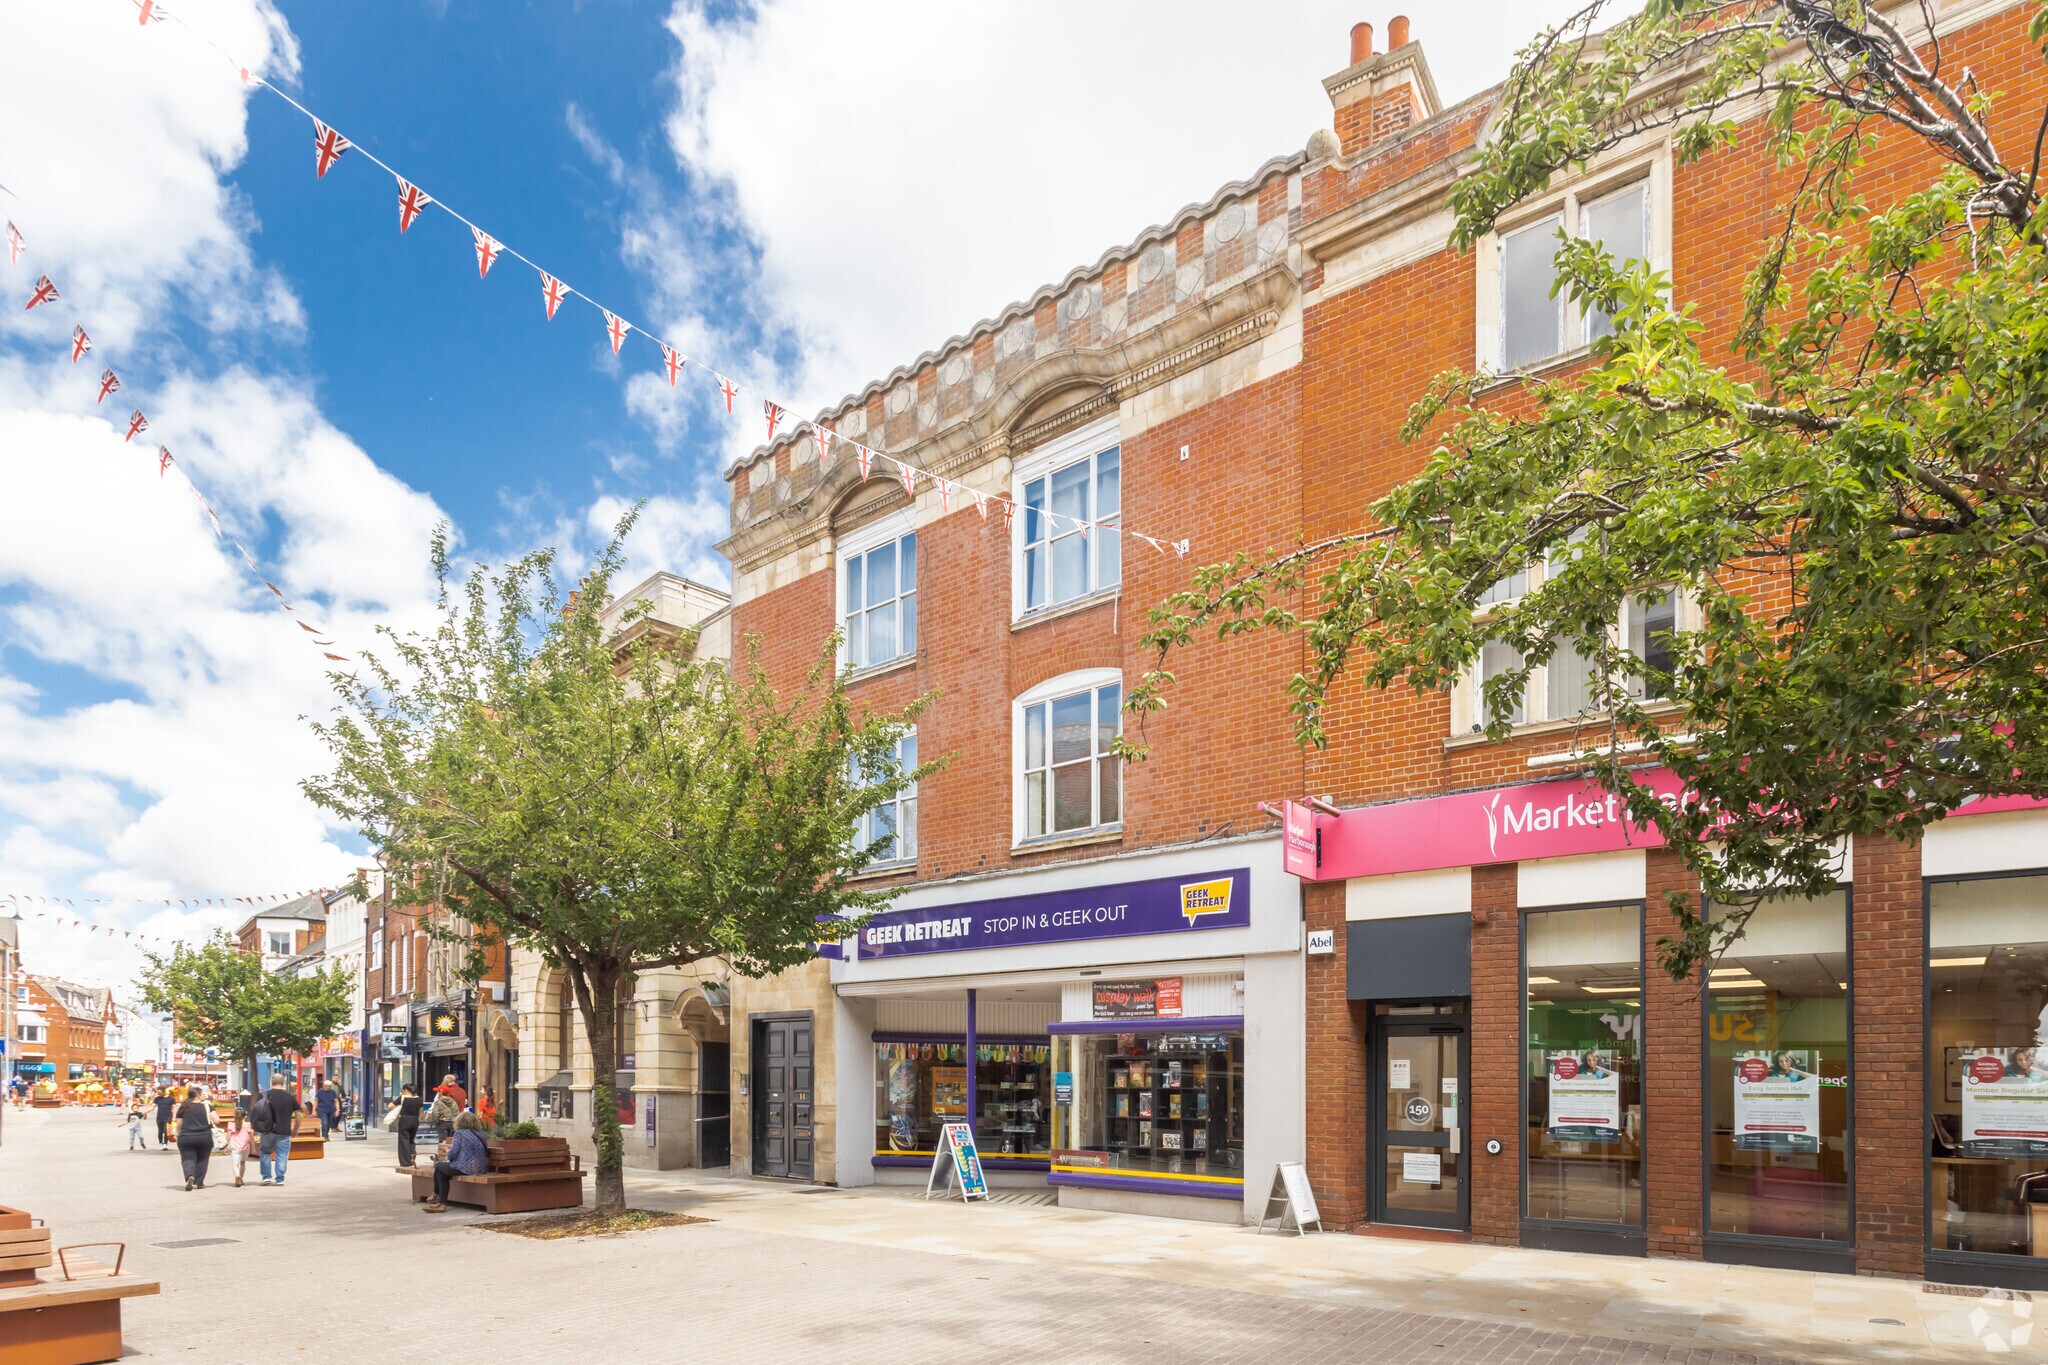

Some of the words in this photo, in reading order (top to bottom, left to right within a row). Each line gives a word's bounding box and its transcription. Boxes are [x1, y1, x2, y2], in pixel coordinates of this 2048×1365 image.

[1503, 792, 1617, 835] Market
[1288, 832, 1316, 853] Harborough
[1186, 888, 1208, 899] GEEK
[1186, 896, 1225, 908] RETREAT
[983, 916, 1019, 934] STOP
[1022, 914, 1036, 930] IN
[1039, 913, 1049, 928] &
[1051, 908, 1092, 927] GEEK
[1094, 904, 1128, 922] OUT
[866, 924, 902, 945] GEEK
[904, 917, 972, 942] RETREAT
[1310, 936, 1332, 948] Abel
[1096, 989, 1131, 1007] cosplay
[1133, 988, 1156, 1003] walk
[1409, 1105, 1429, 1116] 150
